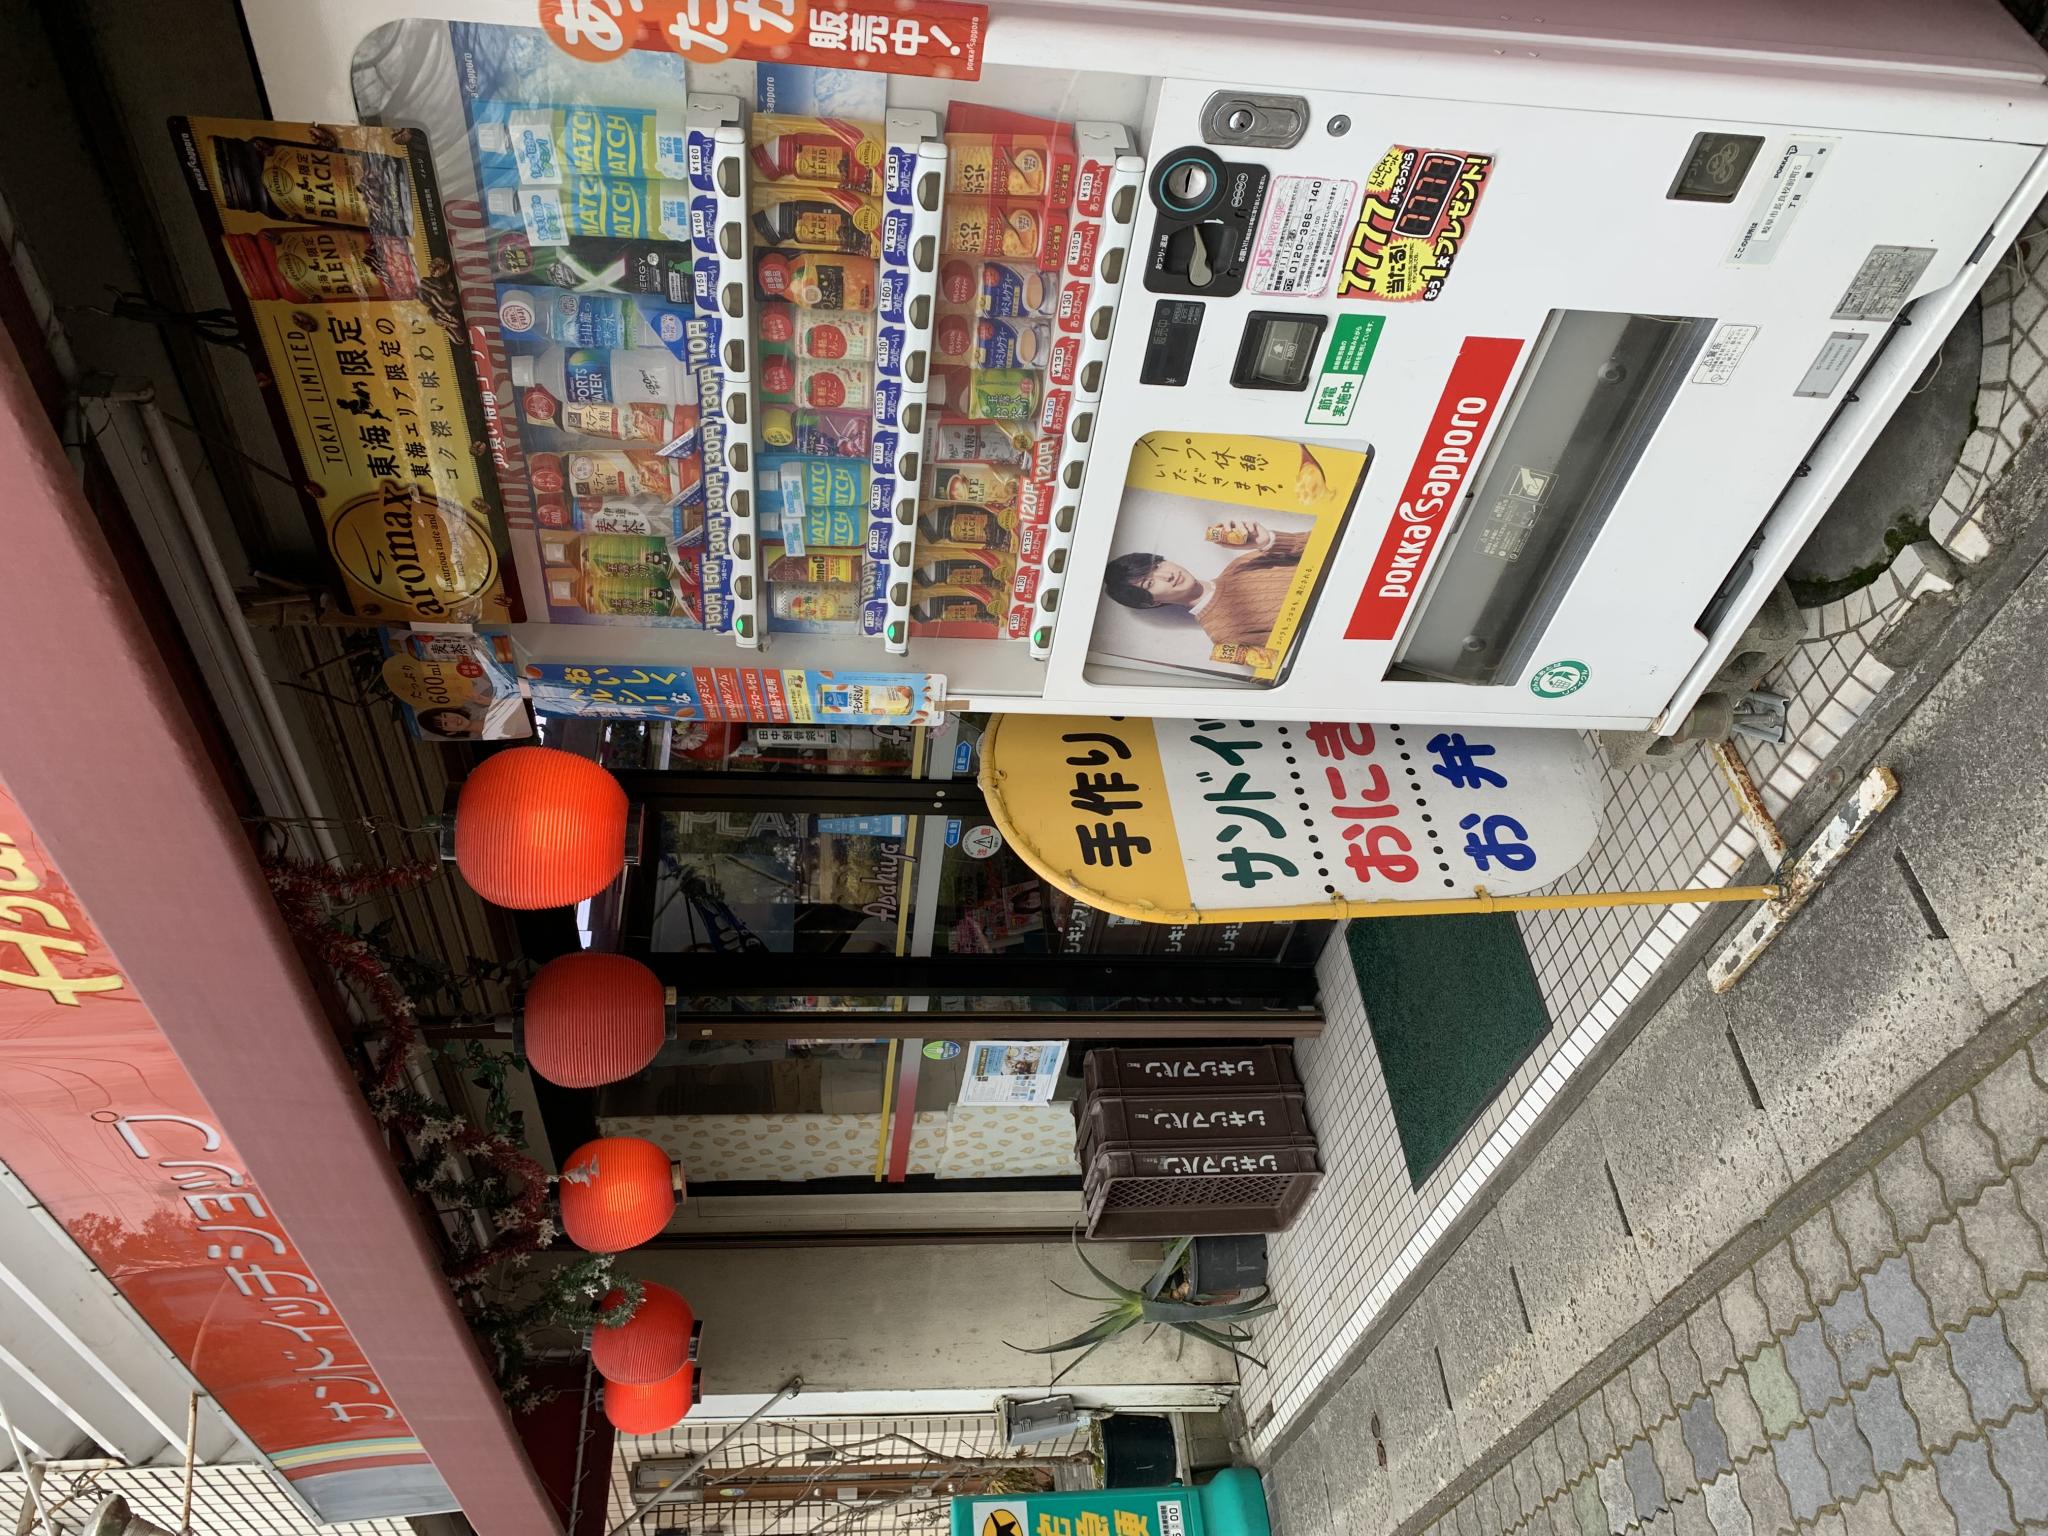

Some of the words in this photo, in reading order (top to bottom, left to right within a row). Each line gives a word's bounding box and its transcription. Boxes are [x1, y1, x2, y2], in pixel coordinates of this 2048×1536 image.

[808, 8, 961, 56] 販売中!
[310, 153, 338, 220] BLACK
[887, 155, 897, 191] ¥130
[1081, 175, 1092, 198] ¥130
[1388, 151, 1415, 205] がそろったら
[1773, 155, 1790, 179] POKKA
[886, 218, 896, 250] ¥130
[1288, 180, 1322, 274] 0120-386-140
[1338, 196, 1397, 295] 7777
[1419, 156, 1489, 300] もう1本プレゼント!
[1733, 222, 1759, 259] ここの住所は
[317, 234, 352, 295] BLEND
[1386, 242, 1408, 294] 当たる!
[1062, 294, 1072, 316] ¥130
[326, 315, 374, 377] 限定
[686, 321, 708, 367] 110円
[828, 332, 839, 356] りんご
[1052, 348, 1062, 375] ¥130
[286, 330, 325, 403] LIMITED
[374, 317, 434, 479] 東海エリア限定の
[410, 318, 459, 480] コク深い味わい
[701, 366, 720, 416] 130円
[827, 381, 838, 406] りんご
[1317, 386, 1338, 411] 節電
[1332, 381, 1355, 417] 実施中
[311, 414, 344, 464] TOKAI
[357, 425, 403, 479] 東海
[705, 425, 724, 468] 130円
[1134, 436, 1270, 473] スープ休憩
[1035, 442, 1054, 481] 120円
[1154, 464, 1285, 496] いただきます。
[707, 472, 725, 514] 130円
[872, 485, 880, 509] ¥130
[595, 518, 646, 534] 麦茶
[707, 517, 726, 557] 130円
[870, 530, 878, 552] ¥130
[1023, 531, 1032, 552] ¥130
[379, 482, 445, 616] aromax
[704, 592, 723, 627] 150円
[402, 664, 423, 700] たっぷり
[423, 663, 451, 704] 600ml
[568, 688, 692, 705] ヘルシーな
[745, 673, 765, 720] コレステロールゼロ
[955, 757, 967, 771] 自動
[1060, 714, 1153, 868] 手作り
[859, 842, 919, 923] Asahiya
[1145, 1060, 1255, 1078] シキシマパン
[1153, 1110, 1266, 1129] シキシマパン
[1163, 1154, 1278, 1174] シキシマパン
[90, 1110, 395, 1423] サンドイッチショップ
